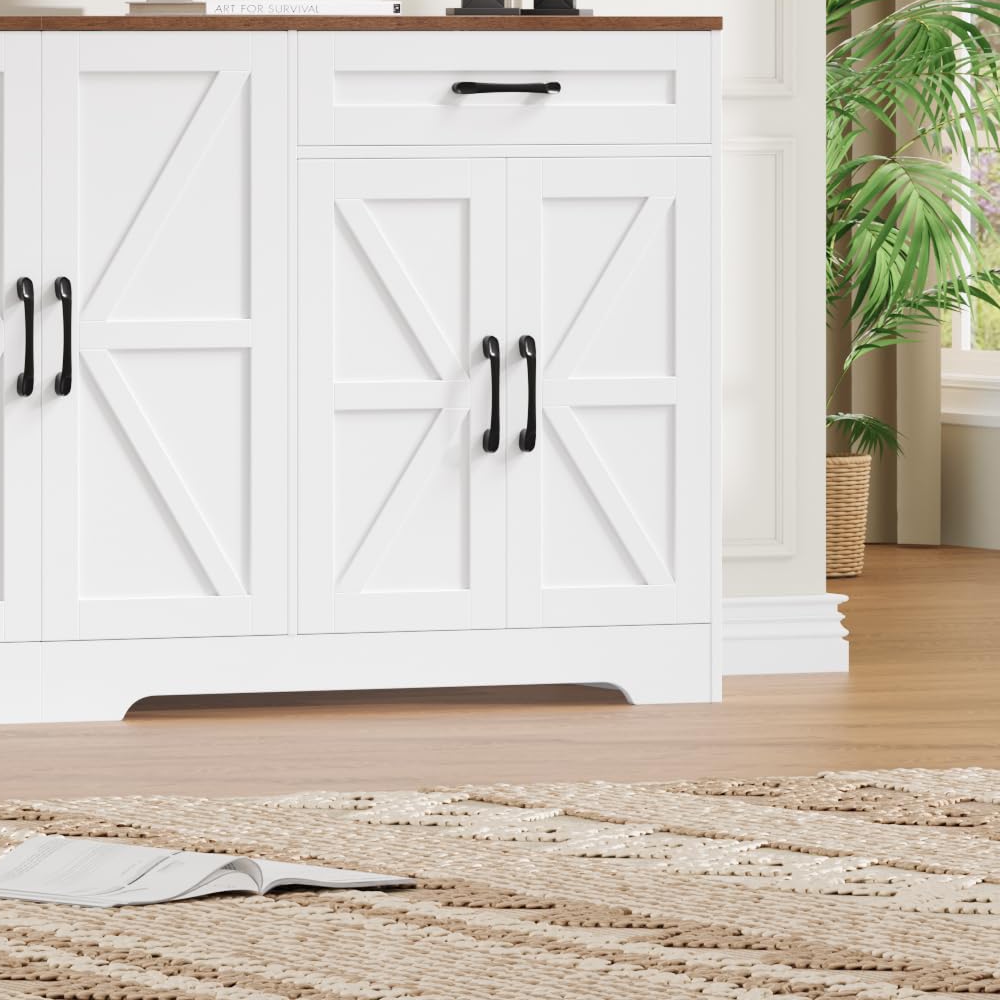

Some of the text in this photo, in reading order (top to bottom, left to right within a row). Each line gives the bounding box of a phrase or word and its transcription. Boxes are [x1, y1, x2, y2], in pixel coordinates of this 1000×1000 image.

[215, 4, 320, 14] ART FOR SURVIVAL
